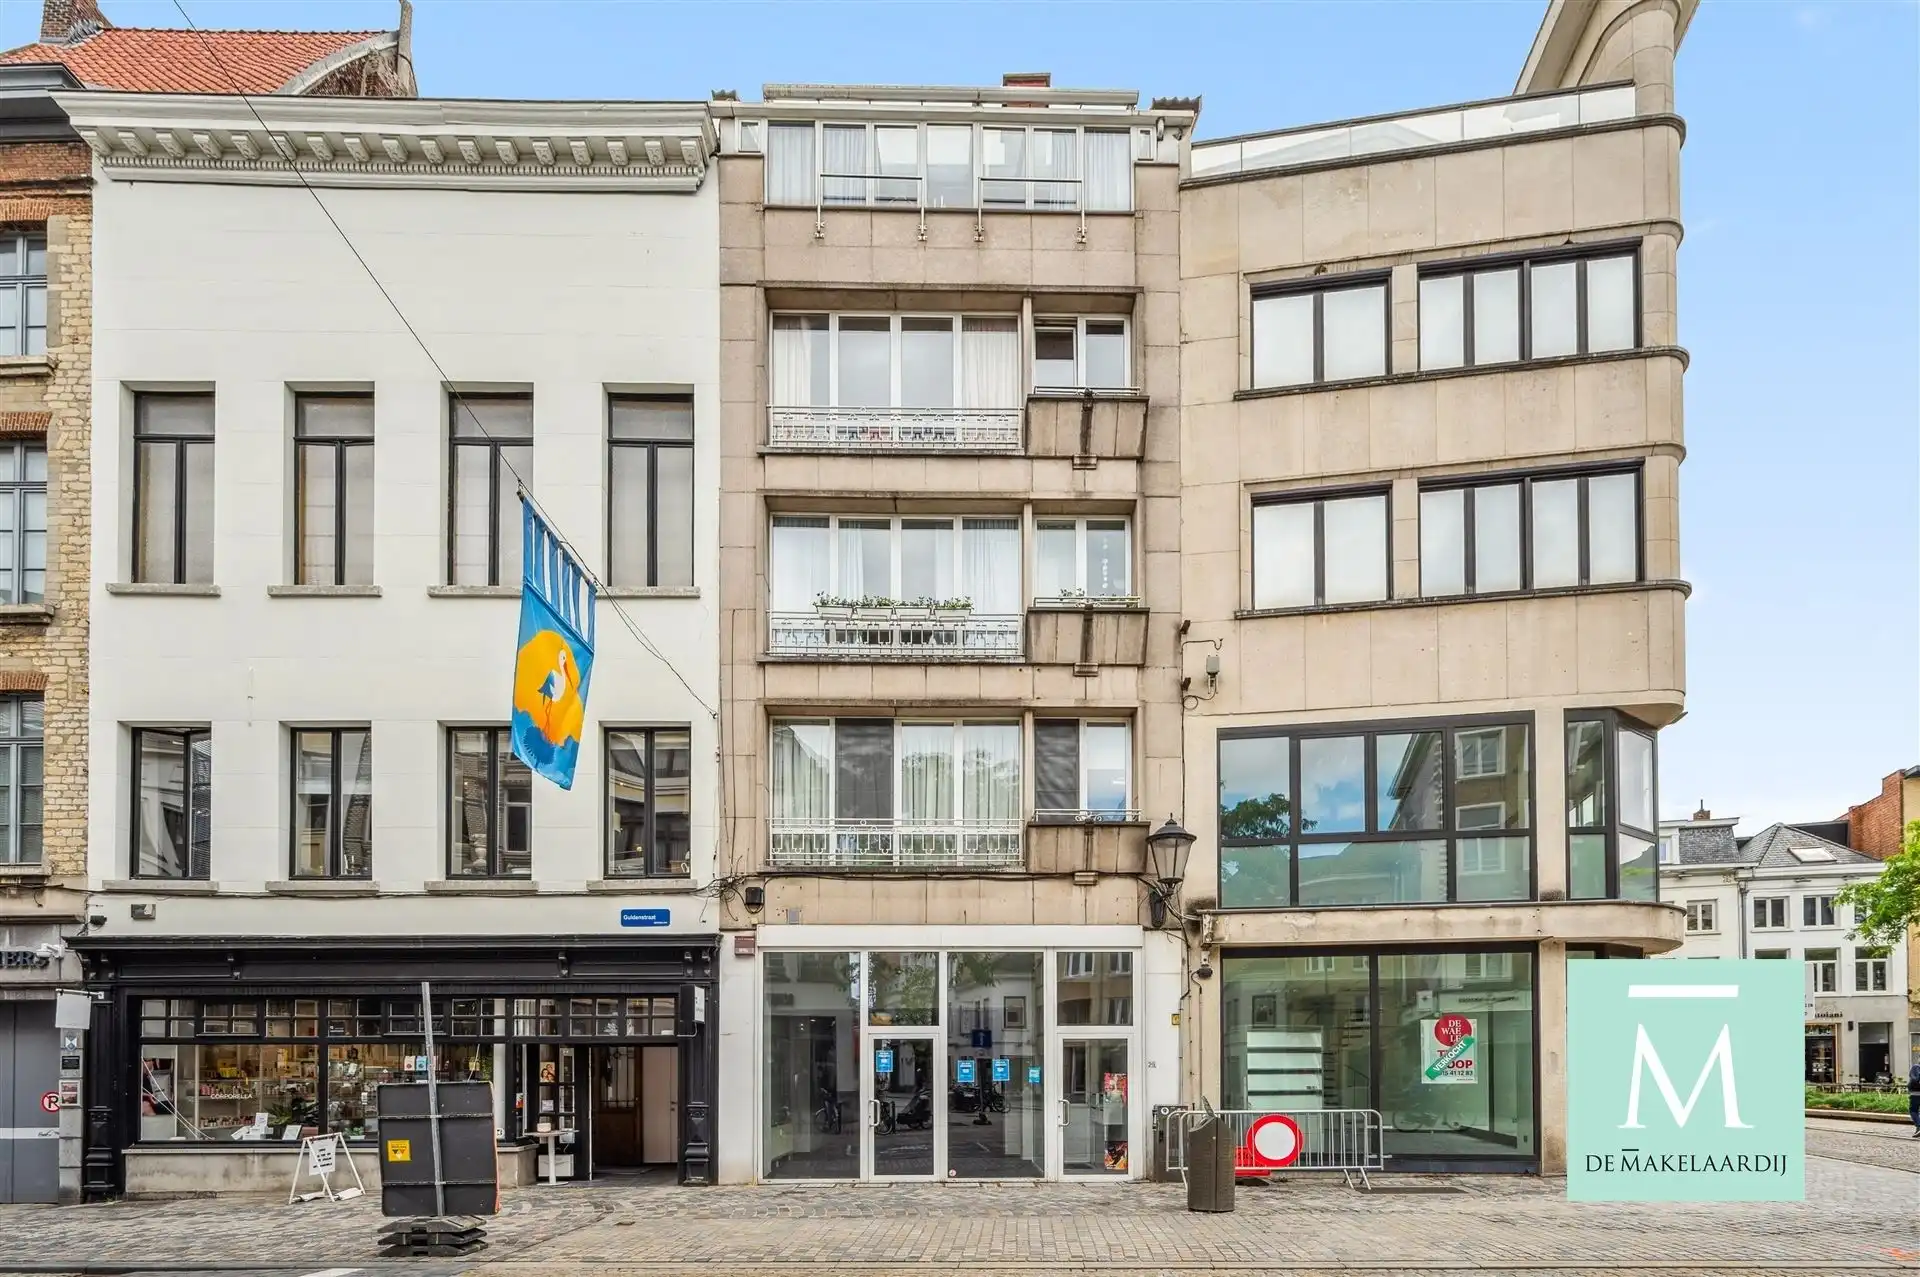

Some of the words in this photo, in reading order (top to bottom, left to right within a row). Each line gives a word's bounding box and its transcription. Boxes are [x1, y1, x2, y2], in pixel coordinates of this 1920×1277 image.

[1448, 1019, 1462, 1027] DE
[1441, 1027, 1462, 1035] WAE
[1432, 1040, 1467, 1072] VERKOCHT
[1447, 1059, 1473, 1069] OOP
